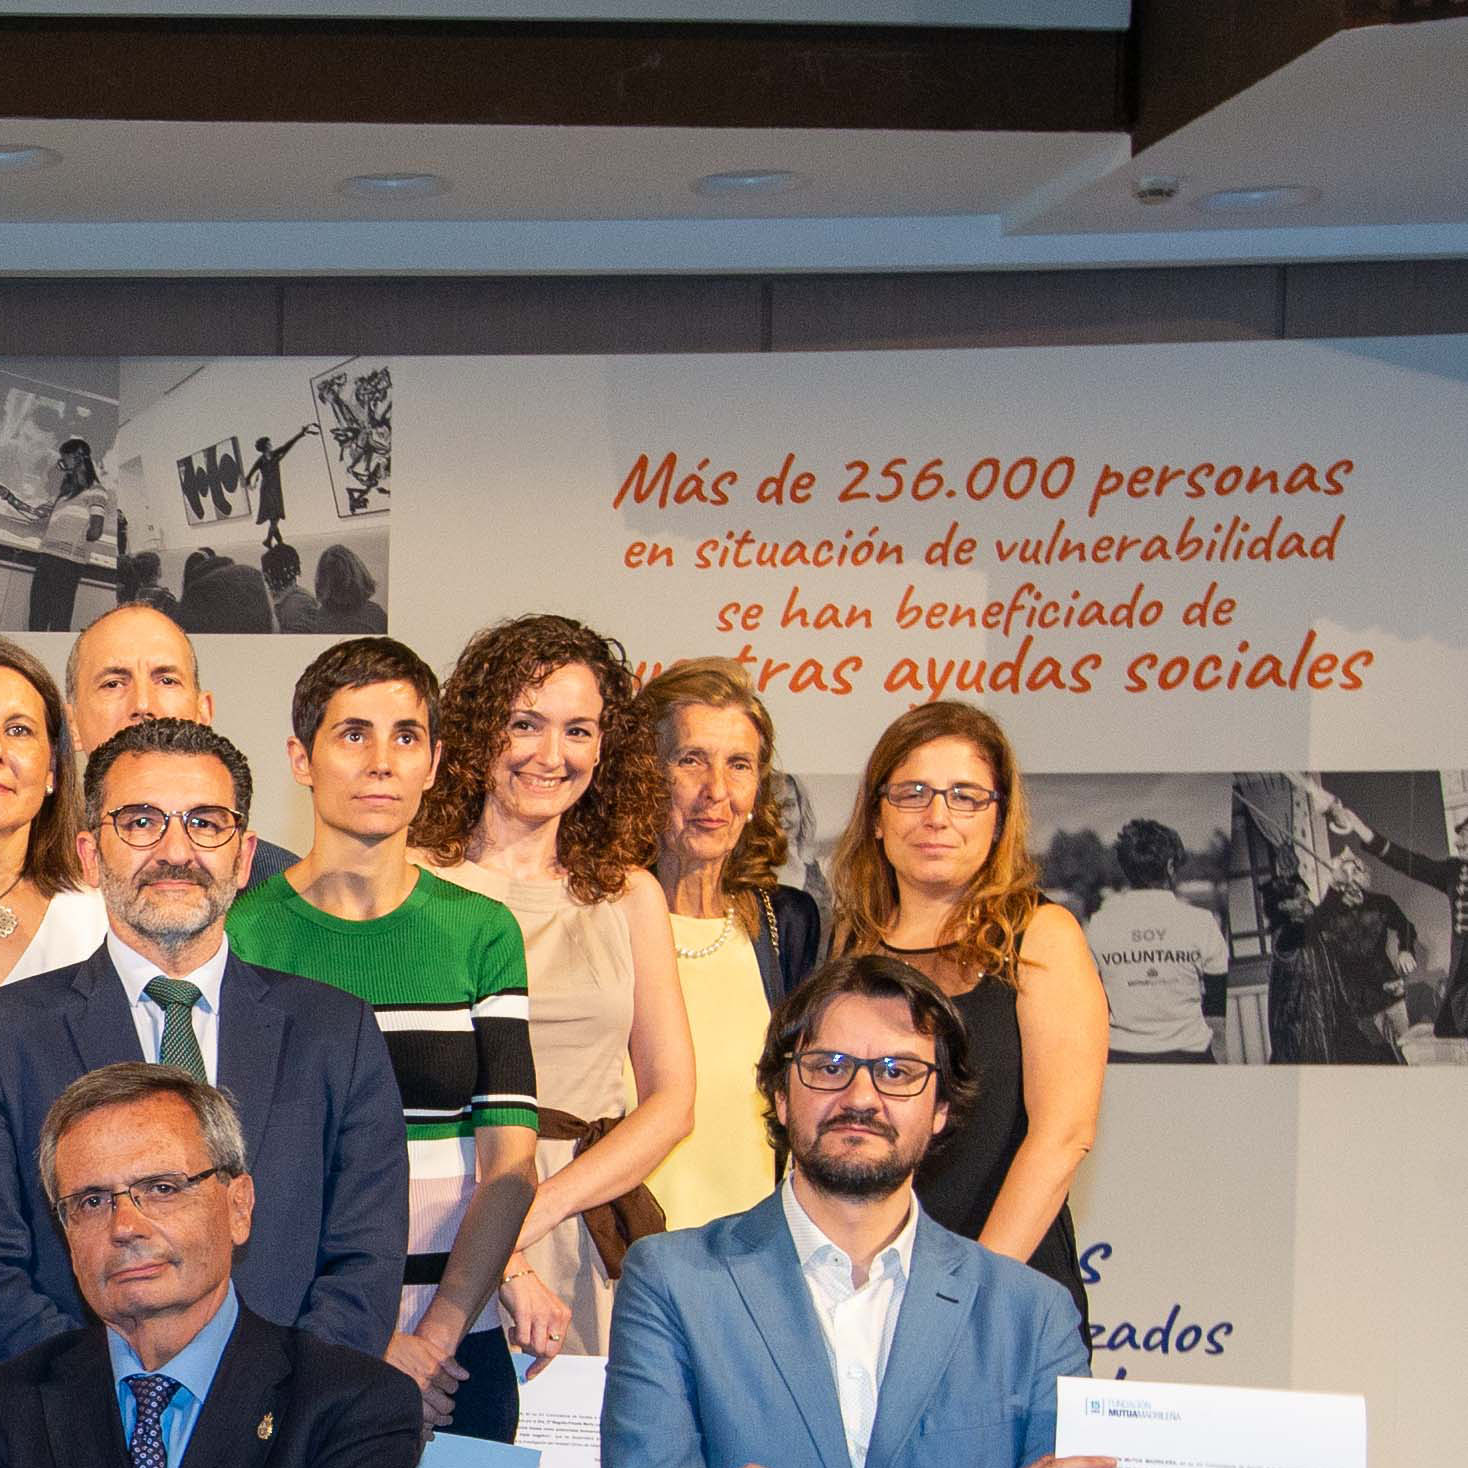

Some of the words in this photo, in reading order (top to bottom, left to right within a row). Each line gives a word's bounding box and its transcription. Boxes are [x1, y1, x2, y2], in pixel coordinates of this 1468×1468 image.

[611, 451, 740, 510] Más
[756, 453, 817, 506] de
[836, 455, 1077, 505] 256.000
[1086, 458, 1355, 518] personas
[622, 541, 675, 570] en
[694, 525, 905, 571] situación
[923, 521, 978, 569] de
[994, 512, 1347, 566] vulnerabilidad
[714, 601, 764, 633] se
[779, 585, 874, 631] han
[895, 582, 1165, 637] beneficiado
[1181, 581, 1238, 628] de
[882, 633, 1102, 710] ayudas
[1123, 629, 1375, 698] sociales
[1101, 950, 1202, 966] VOLUNTARIO
[1131, 928, 1166, 942] SOY
